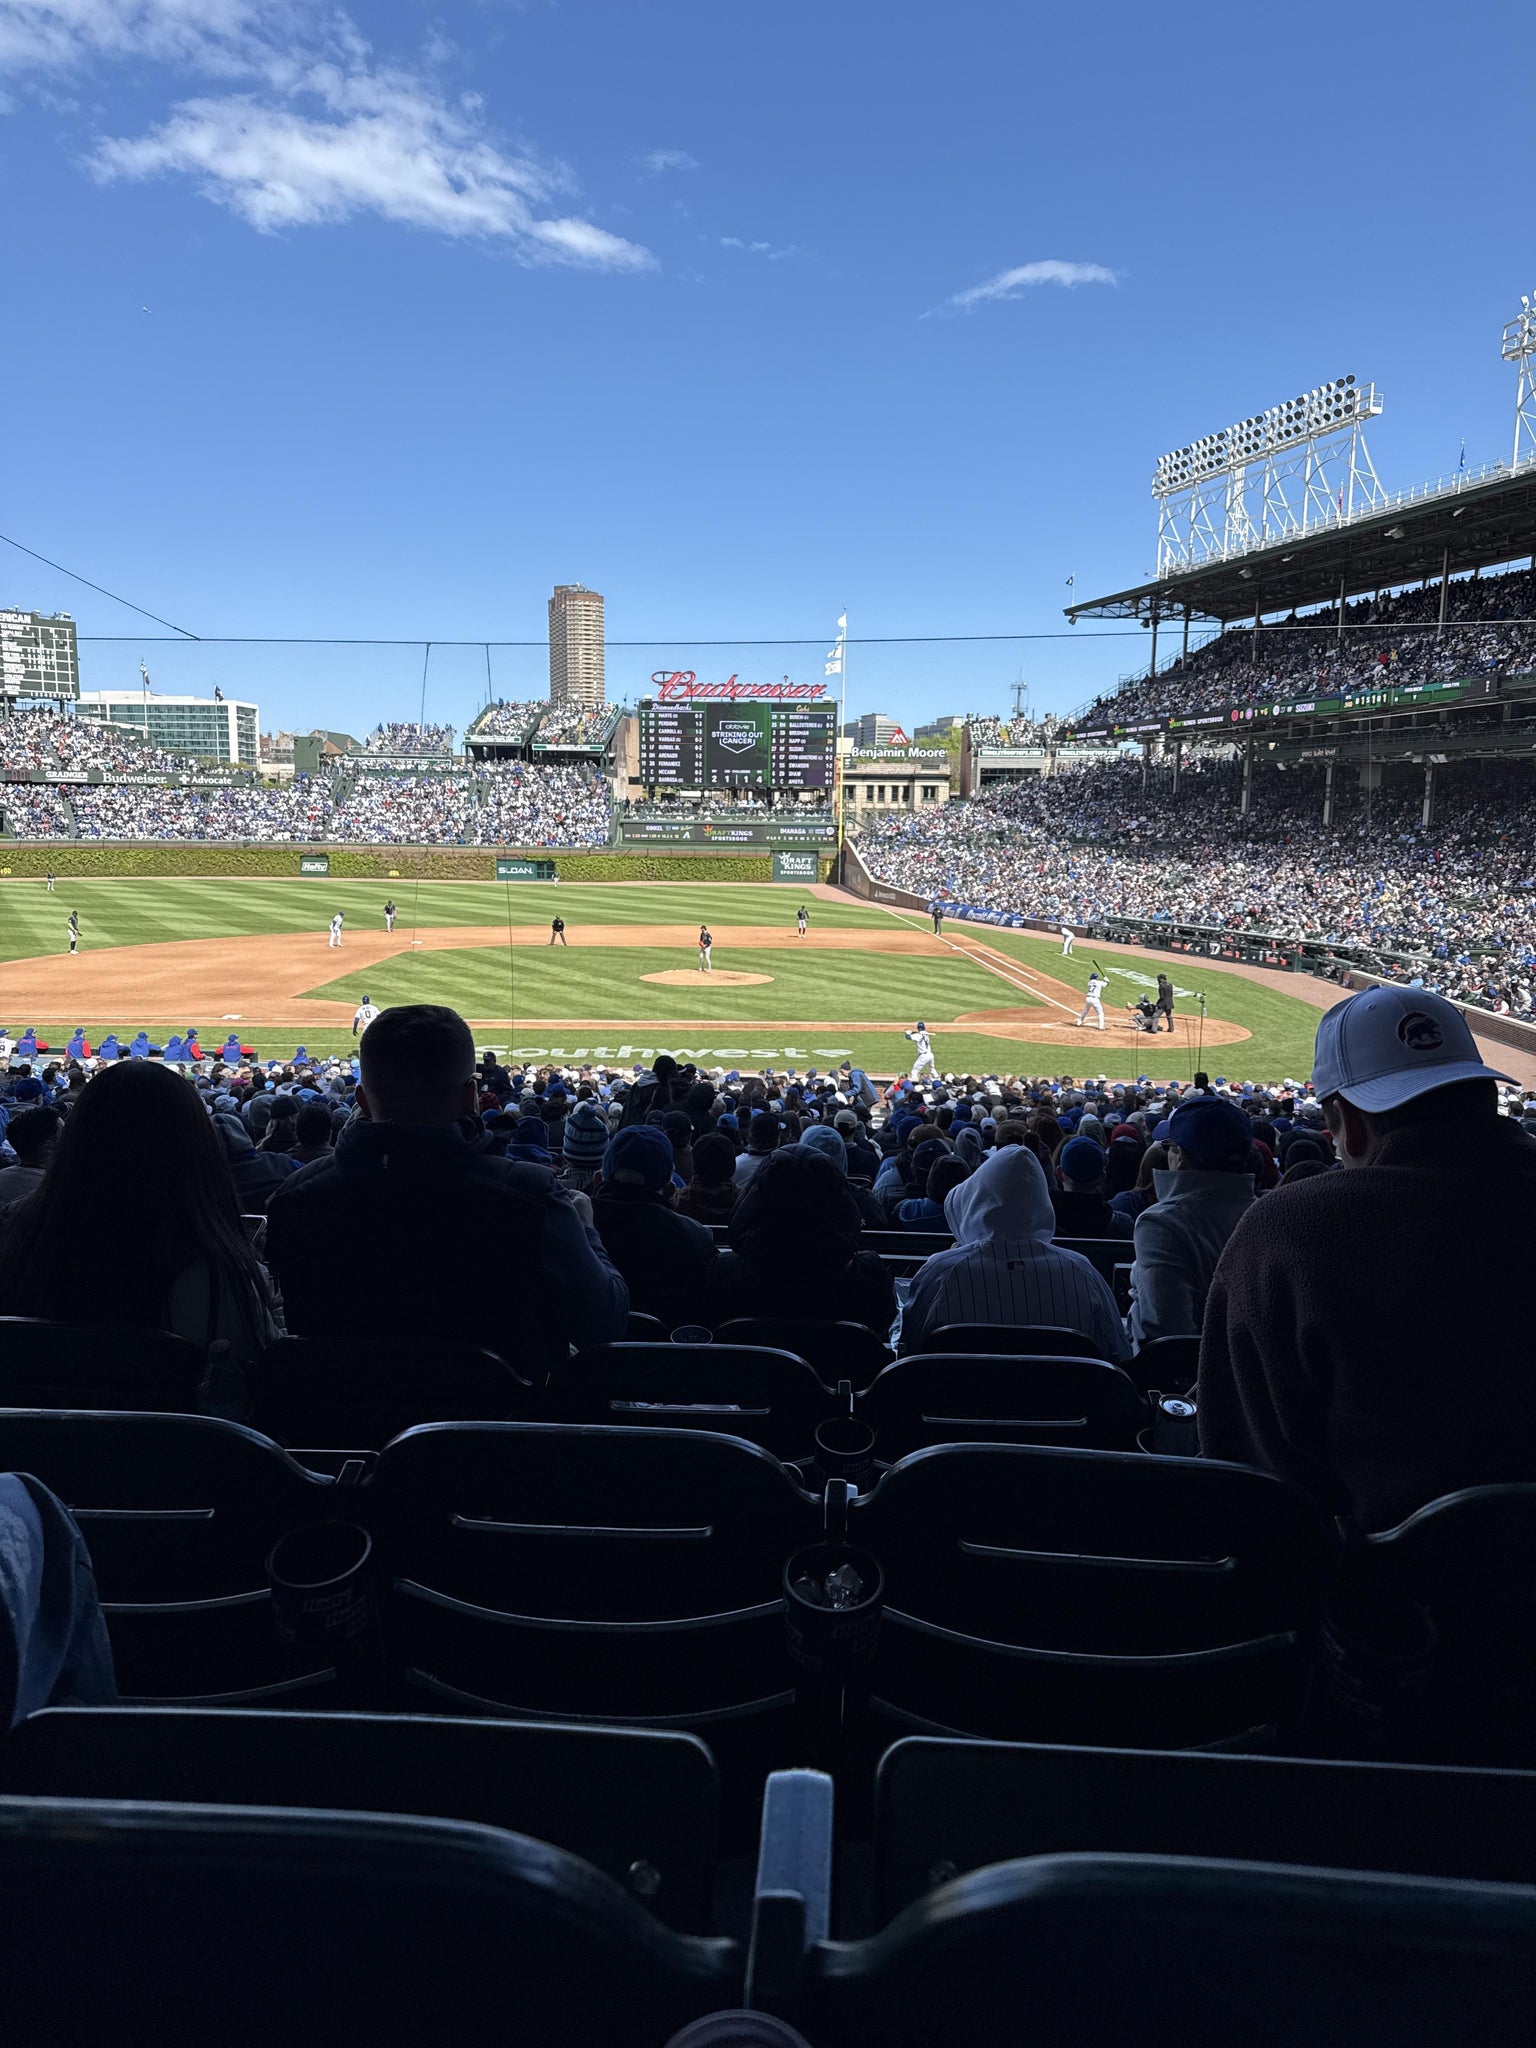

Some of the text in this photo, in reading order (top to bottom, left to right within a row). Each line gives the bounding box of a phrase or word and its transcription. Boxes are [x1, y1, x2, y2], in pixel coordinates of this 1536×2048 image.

[651, 671, 827, 700] Budweiser
[851, 746, 946, 760] Benjamin Moore
[46, 771, 88, 779] GRAINGER
[191, 776, 233, 785] Advocate
[711, 775, 762, 783] 2 1 1 4
[704, 829, 753, 837] DRAFTKINGS
[303, 863, 327, 871] Hefty
[365, 1010, 371, 1018] 0
[474, 1045, 808, 1058] Southwest
